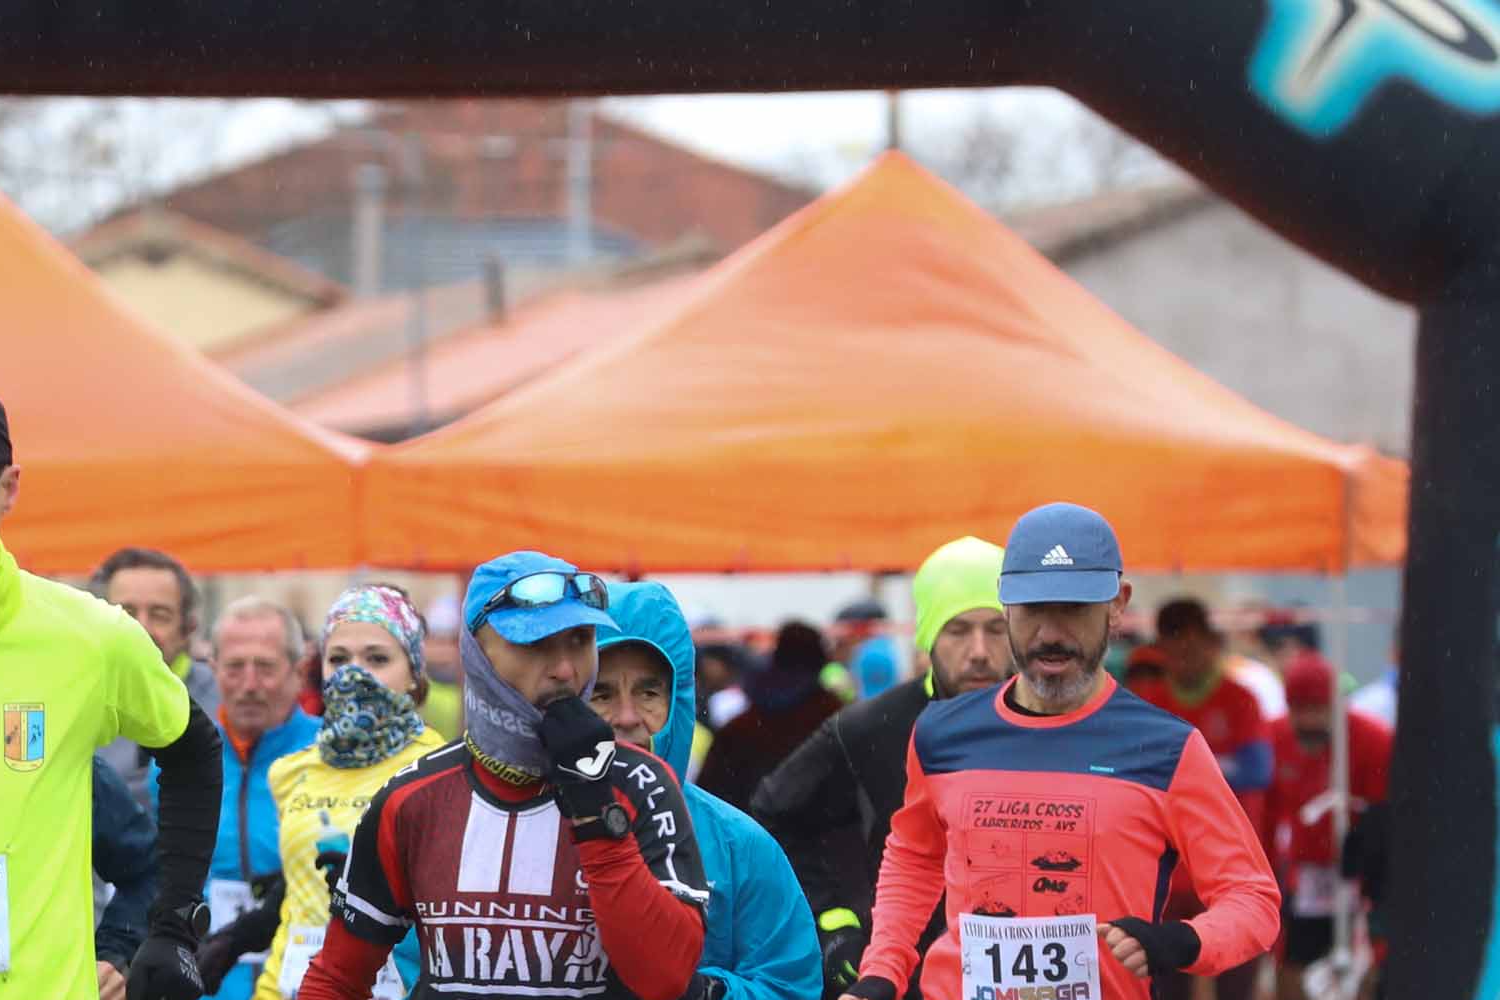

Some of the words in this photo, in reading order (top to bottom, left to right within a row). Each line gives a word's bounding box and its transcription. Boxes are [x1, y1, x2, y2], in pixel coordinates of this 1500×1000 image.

[973, 799, 992, 814] 27
[997, 800, 1030, 816] LIGA
[1035, 802, 1084, 818] CROSS
[973, 817, 1044, 830] CABRERIZOS
[1055, 820, 1077, 832] AVS
[416, 901, 596, 923] RUNNING
[1004, 926, 1034, 941] CROSS
[984, 942, 1069, 984] 143
